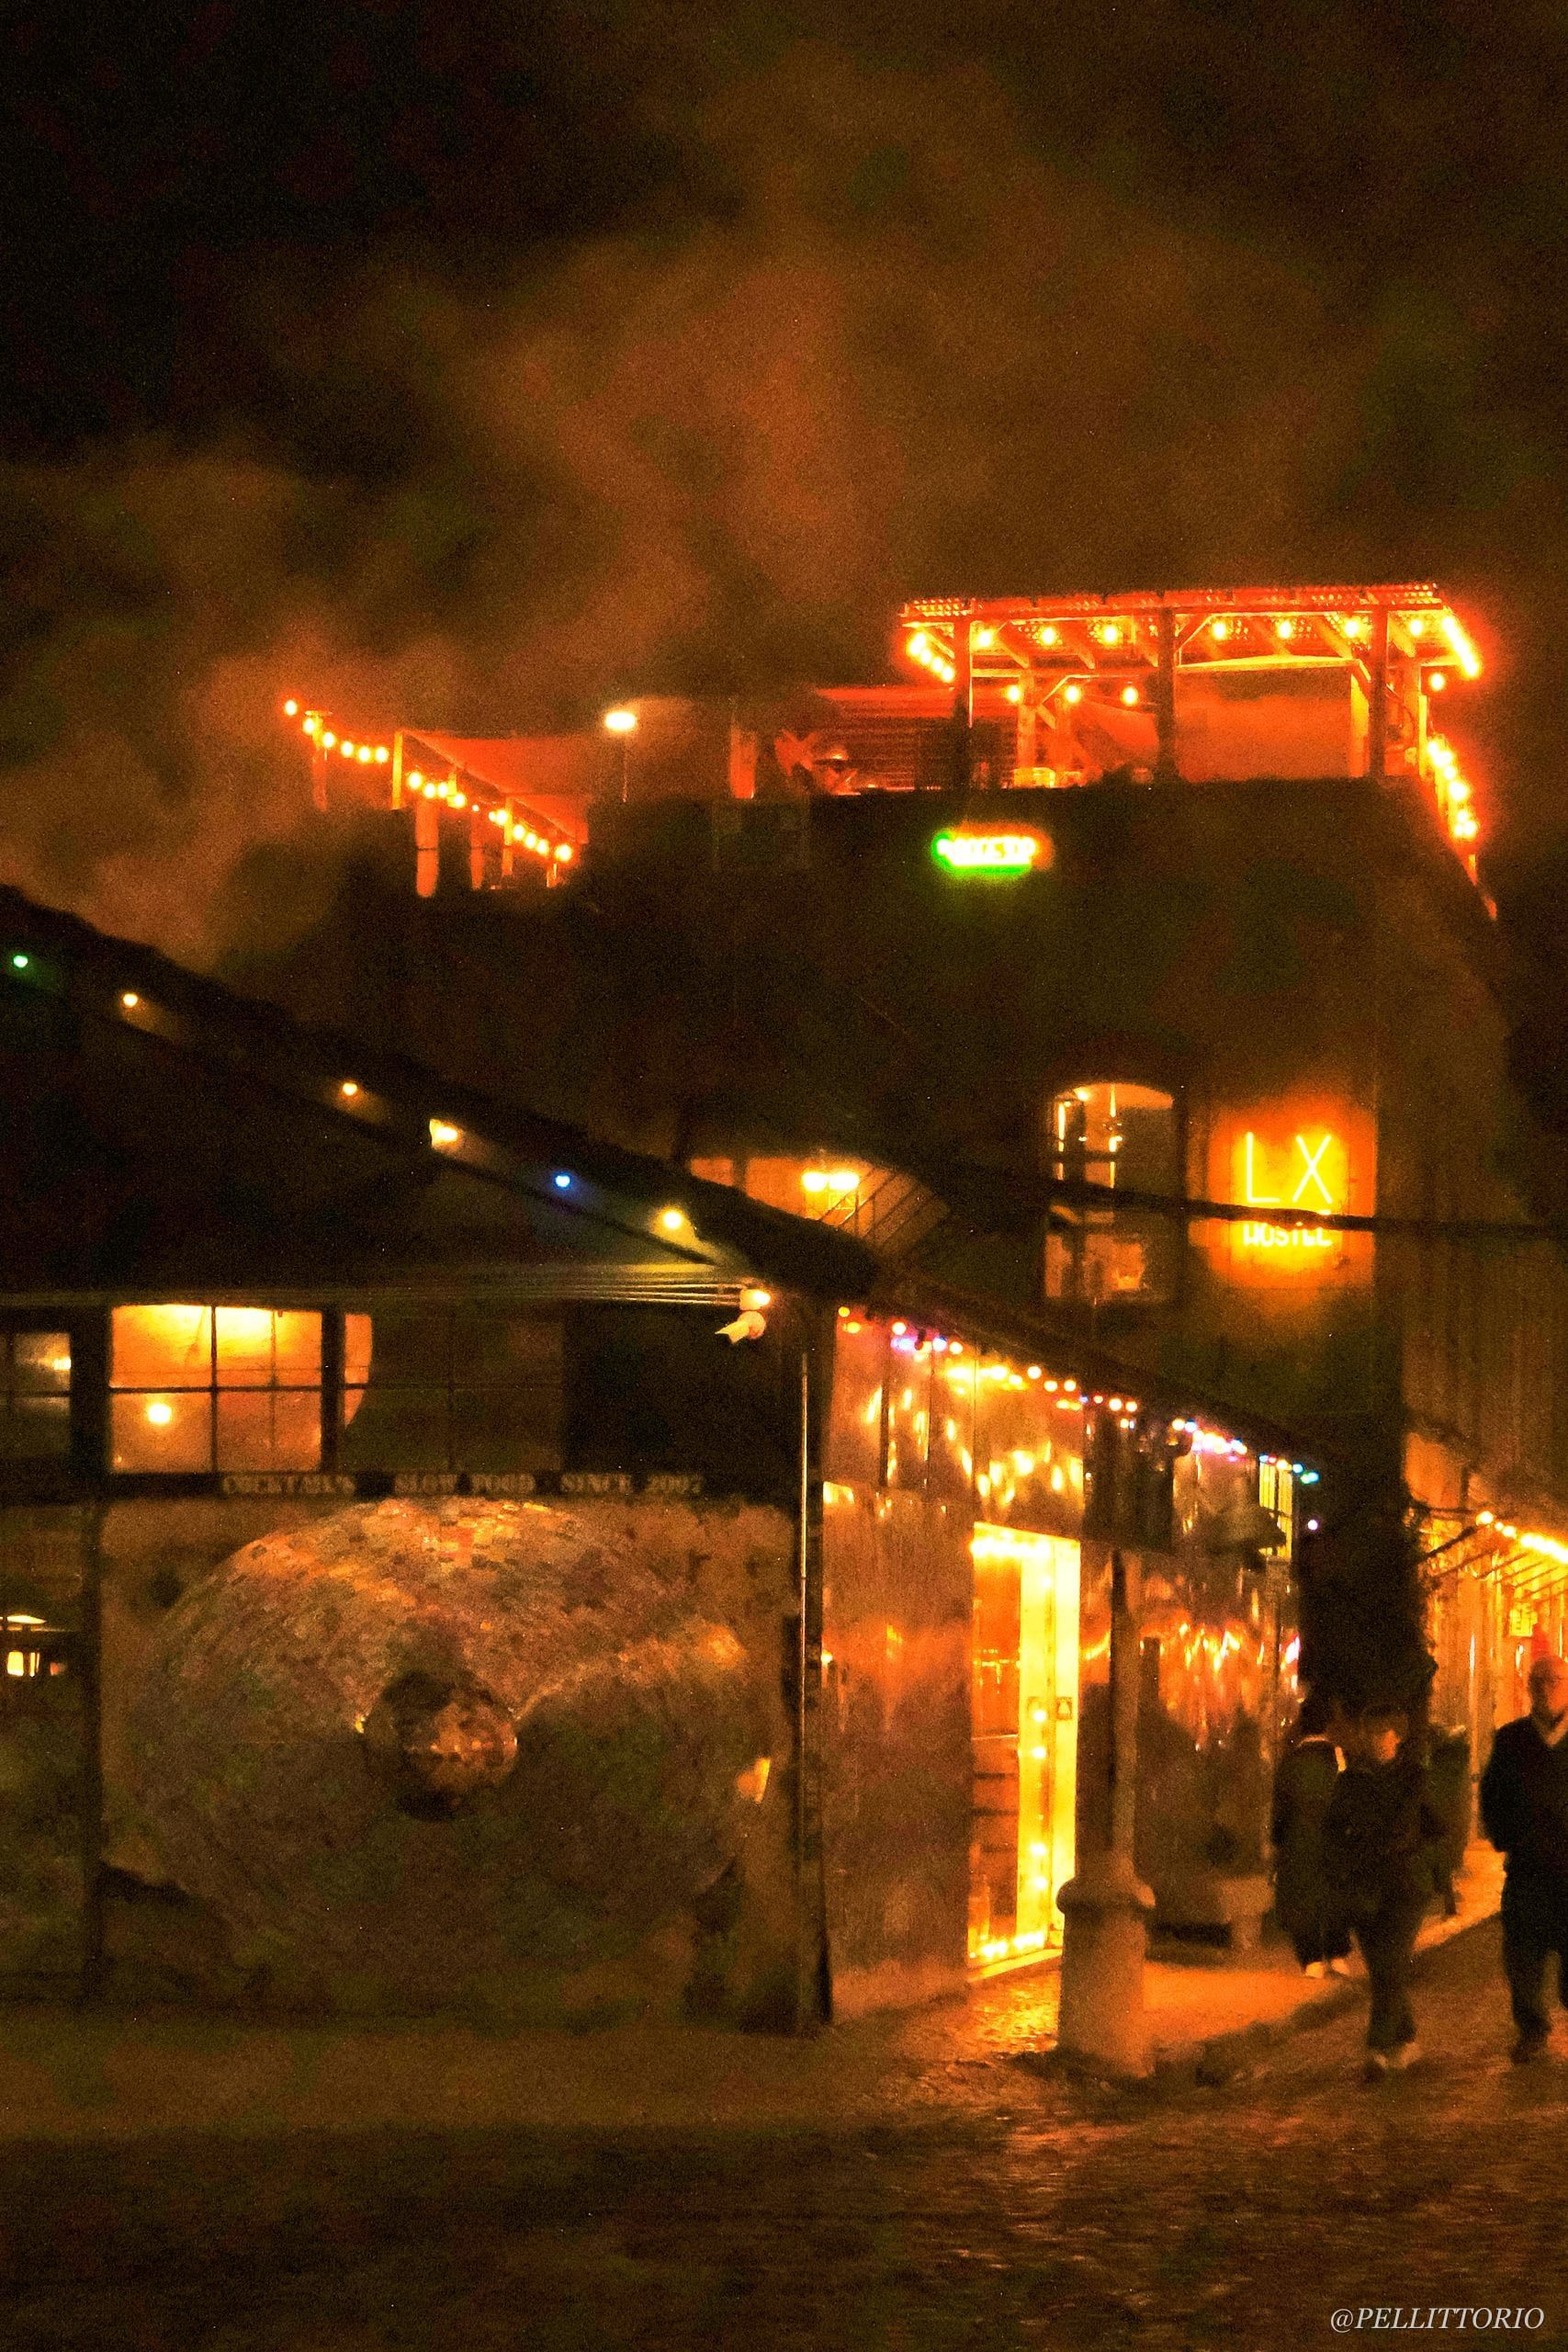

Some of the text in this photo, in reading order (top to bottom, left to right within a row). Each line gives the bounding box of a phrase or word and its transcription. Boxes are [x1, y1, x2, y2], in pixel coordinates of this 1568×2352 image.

[1247, 1131, 1333, 1204] LX
[1243, 1221, 1333, 1247] HOSTEL
[393, 1473, 457, 1495] SLOW
[470, 1473, 536, 1494] FOOD
[560, 1473, 634, 1494] SINCE
